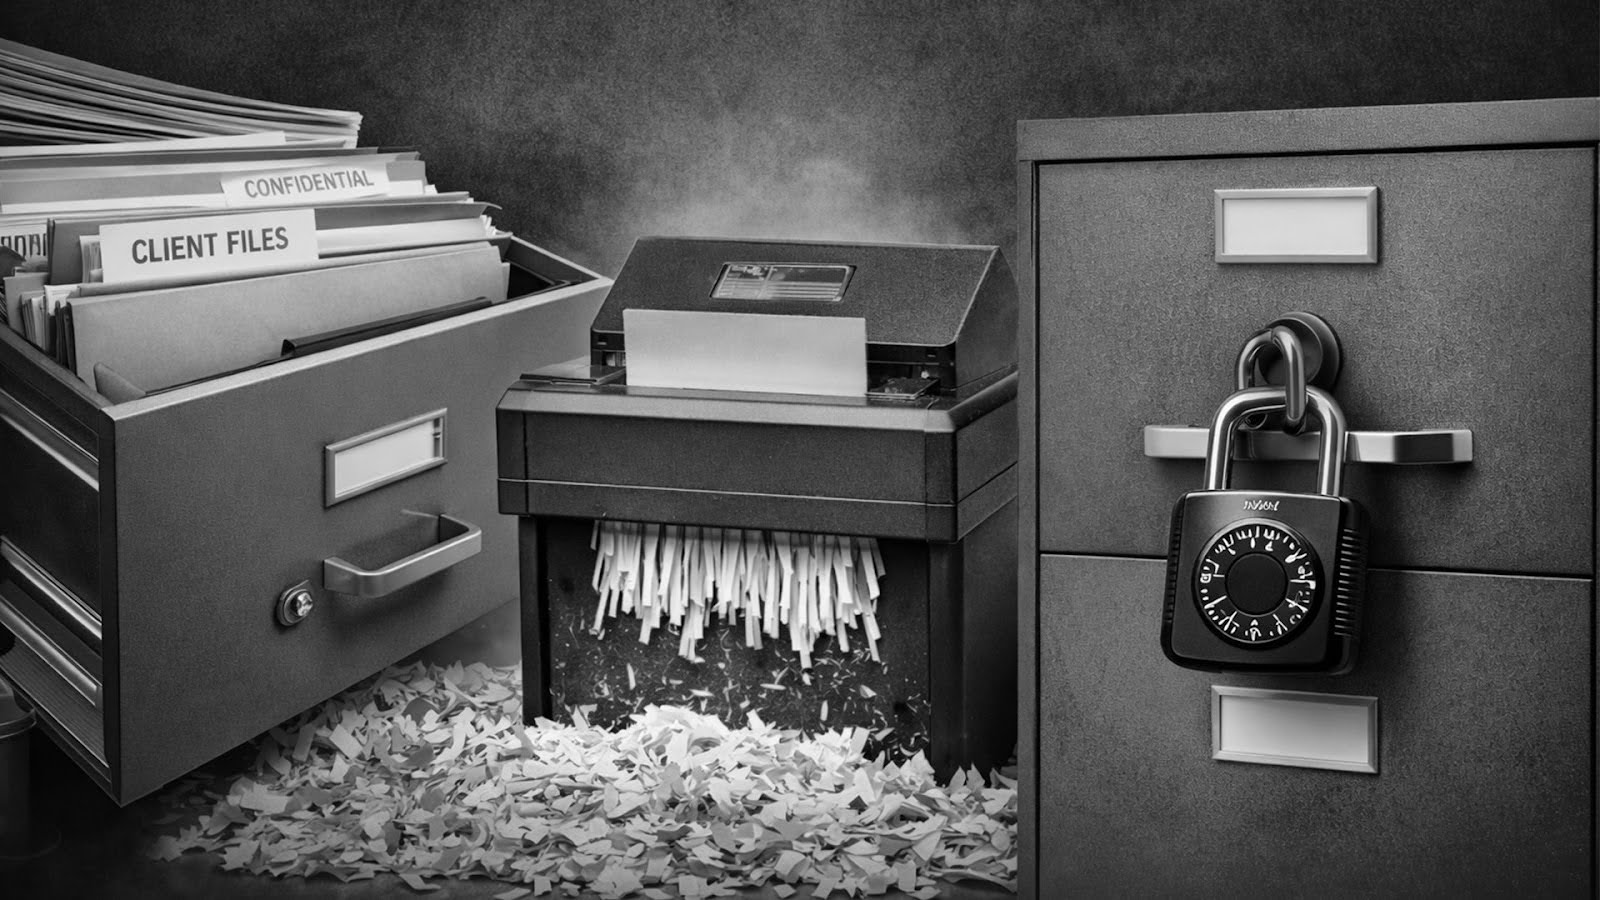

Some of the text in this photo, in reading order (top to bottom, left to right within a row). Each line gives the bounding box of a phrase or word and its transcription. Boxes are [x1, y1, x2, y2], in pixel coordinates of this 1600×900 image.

[244, 169, 375, 199] CONFIDENTIAL
[131, 226, 289, 265] CLIENT FILES
